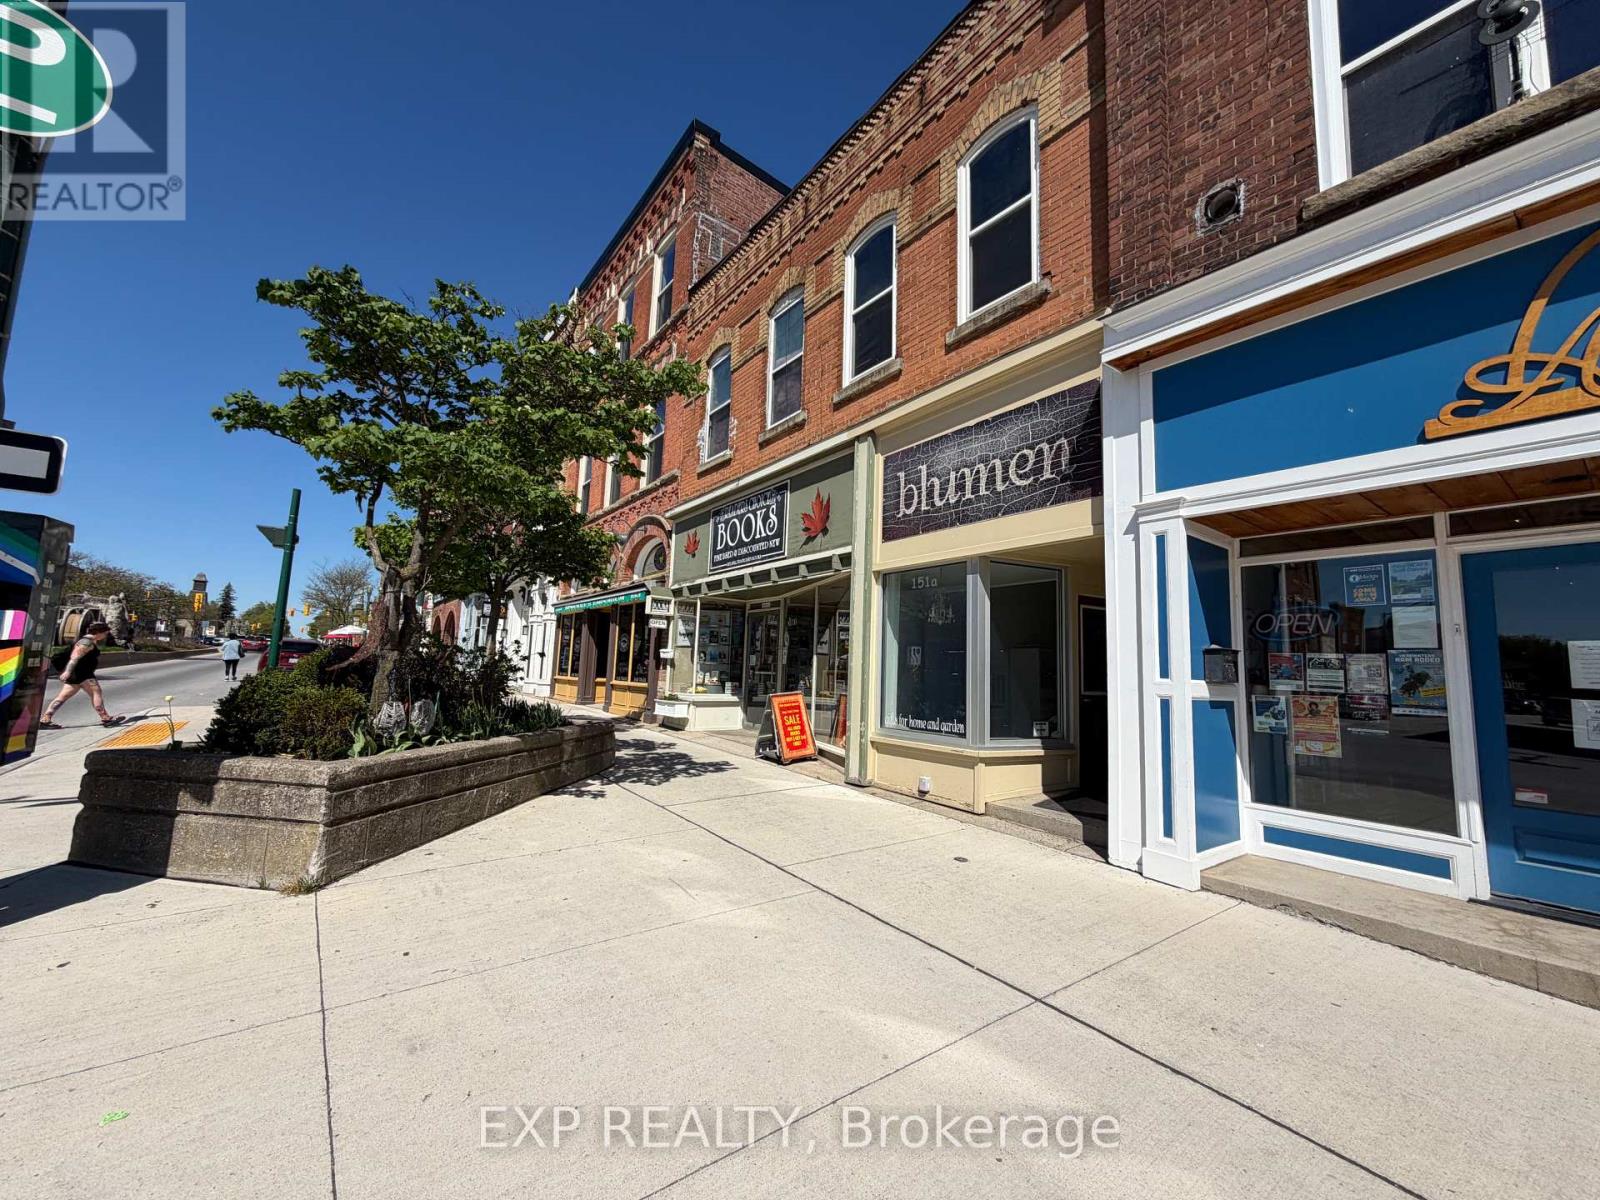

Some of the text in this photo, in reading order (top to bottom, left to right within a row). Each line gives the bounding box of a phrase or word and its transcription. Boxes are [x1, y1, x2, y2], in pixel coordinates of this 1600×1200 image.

[897, 436, 1071, 518] blumen
[717, 505, 778, 550] BOOKS
[911, 575, 937, 589] 151a
[1256, 613, 1334, 634] OPEN
[784, 714, 801, 725] SALE
[899, 713, 908, 728] for
[909, 714, 927, 728] home
[927, 717, 940, 731] and
[940, 718, 965, 735] garden
